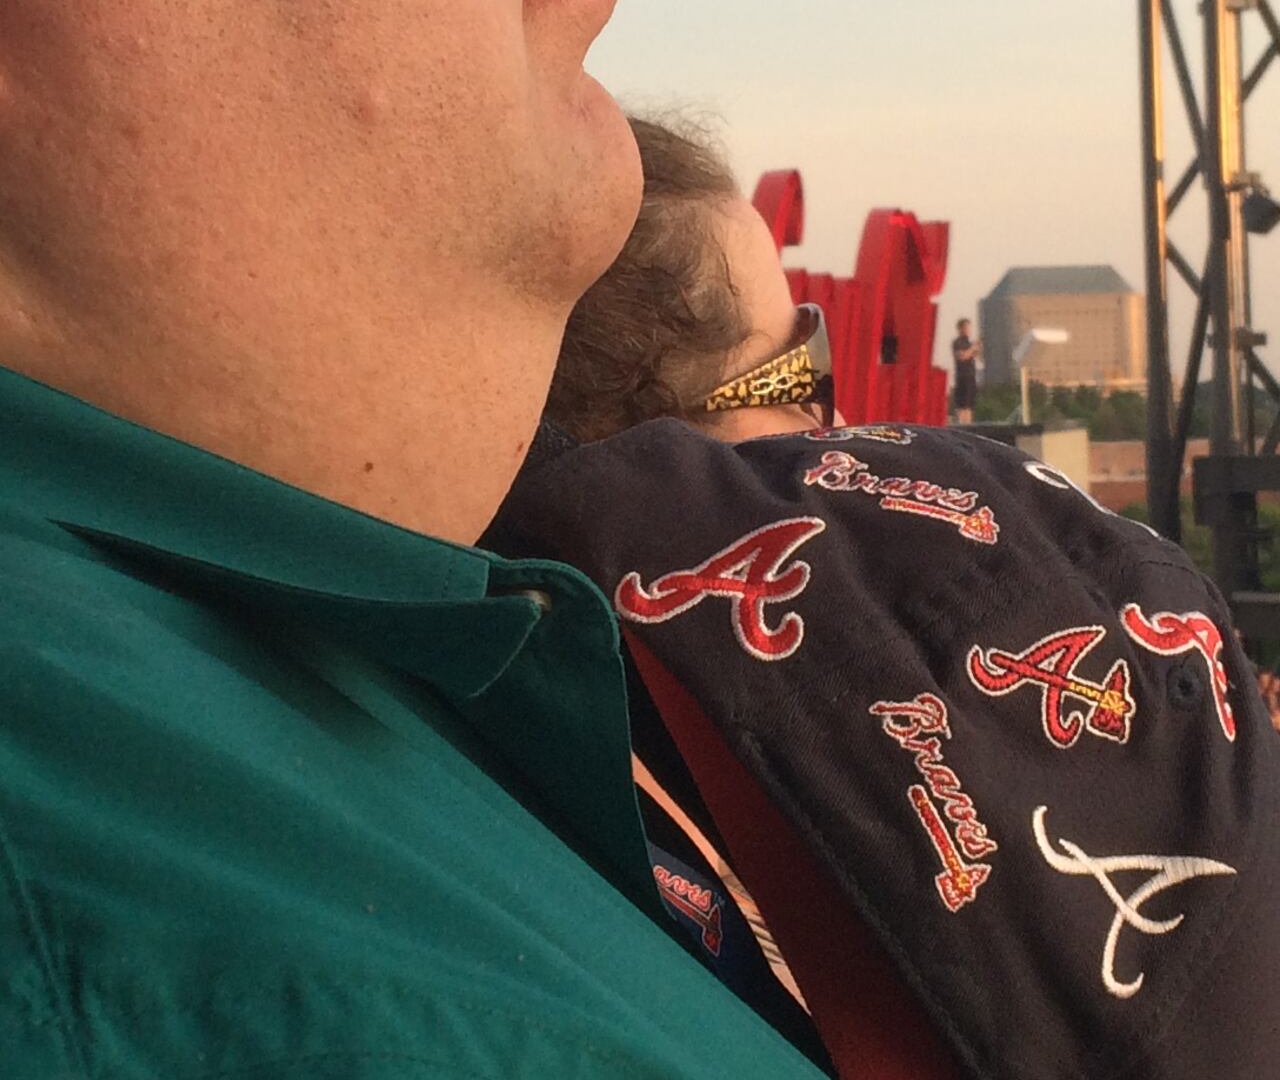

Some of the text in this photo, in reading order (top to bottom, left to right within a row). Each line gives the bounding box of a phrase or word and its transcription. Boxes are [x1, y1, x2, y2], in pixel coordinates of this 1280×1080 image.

[804, 450, 979, 510] Braves
[615, 515, 826, 662] A
[967, 625, 1120, 749] A
[869, 692, 999, 859] Braves
[1032, 804, 1238, 999] A
